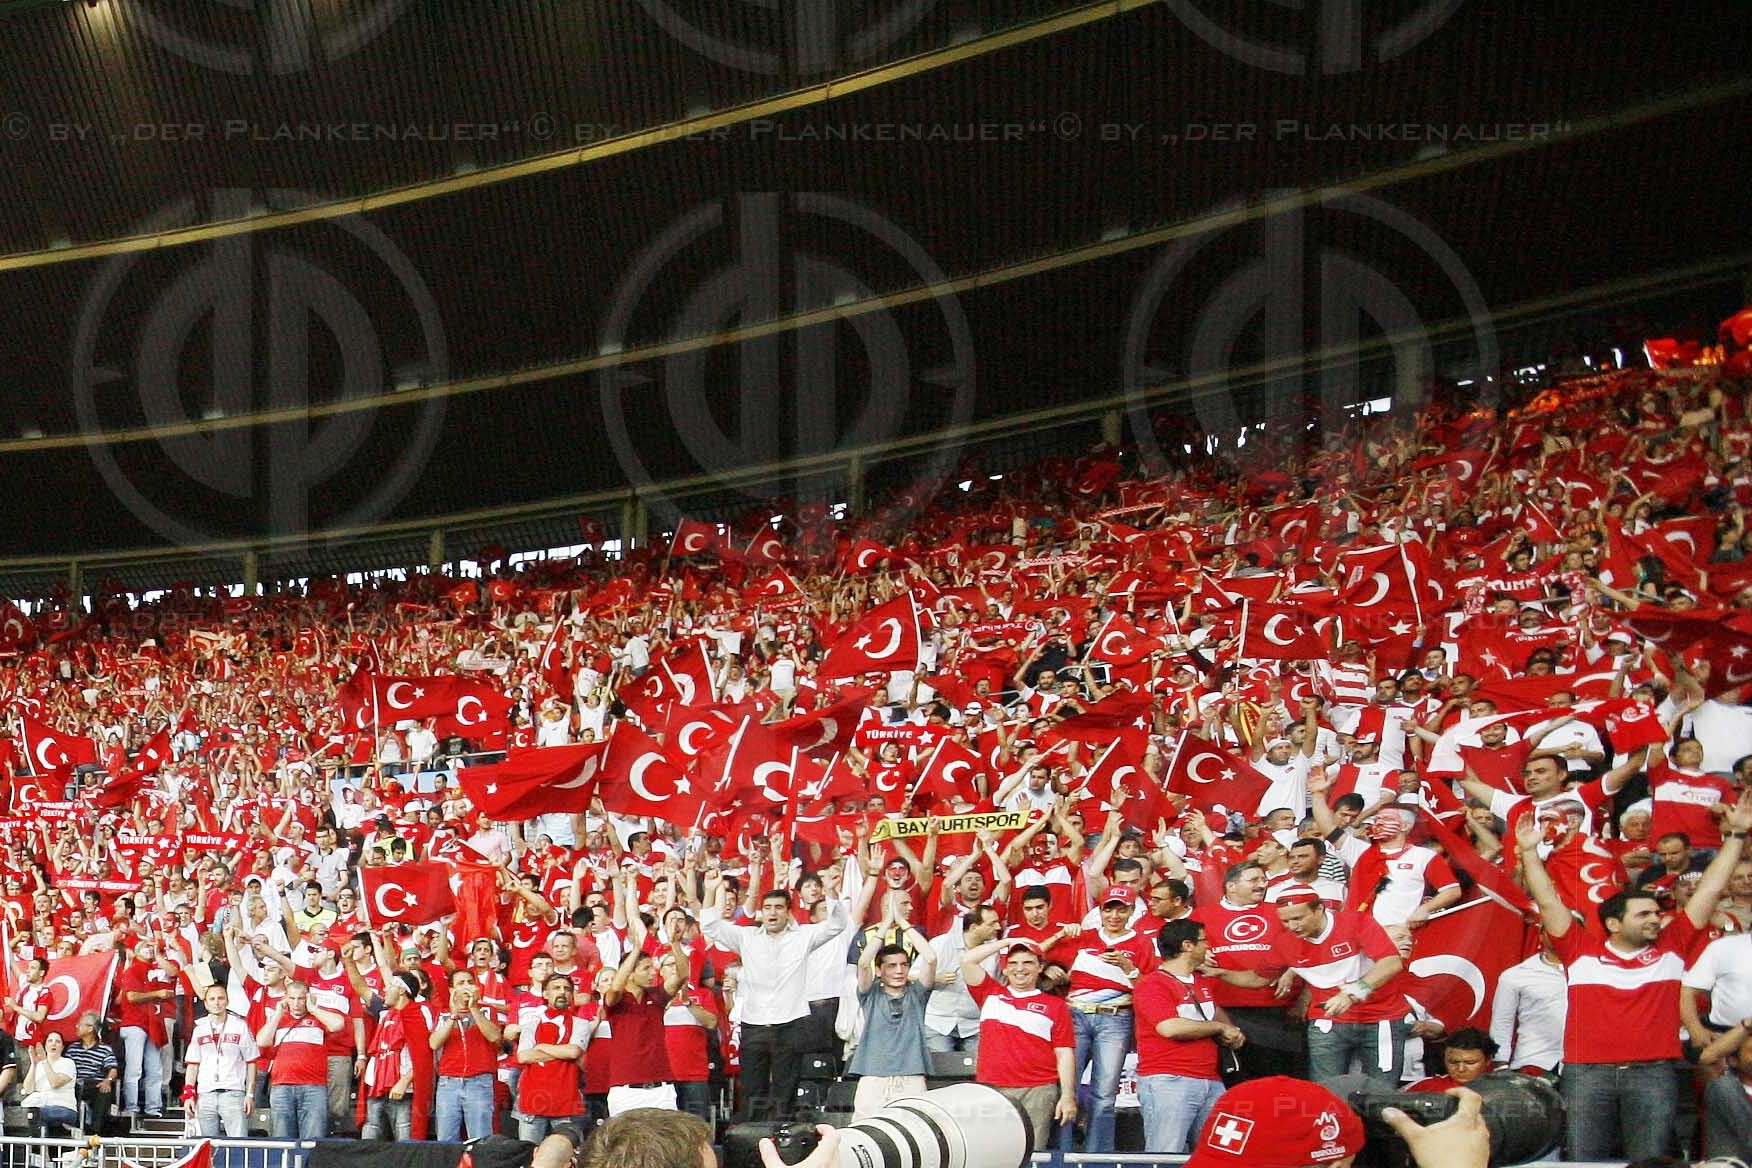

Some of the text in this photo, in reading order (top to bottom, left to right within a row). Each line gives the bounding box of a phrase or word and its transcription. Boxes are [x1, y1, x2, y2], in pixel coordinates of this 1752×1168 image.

[865, 729, 913, 742] TÜRKİYE
[896, 811, 1020, 836] BAYURTSPOR
[119, 835, 155, 845] TÜRKİYE
[186, 834, 224, 845] TÜRKİYE
